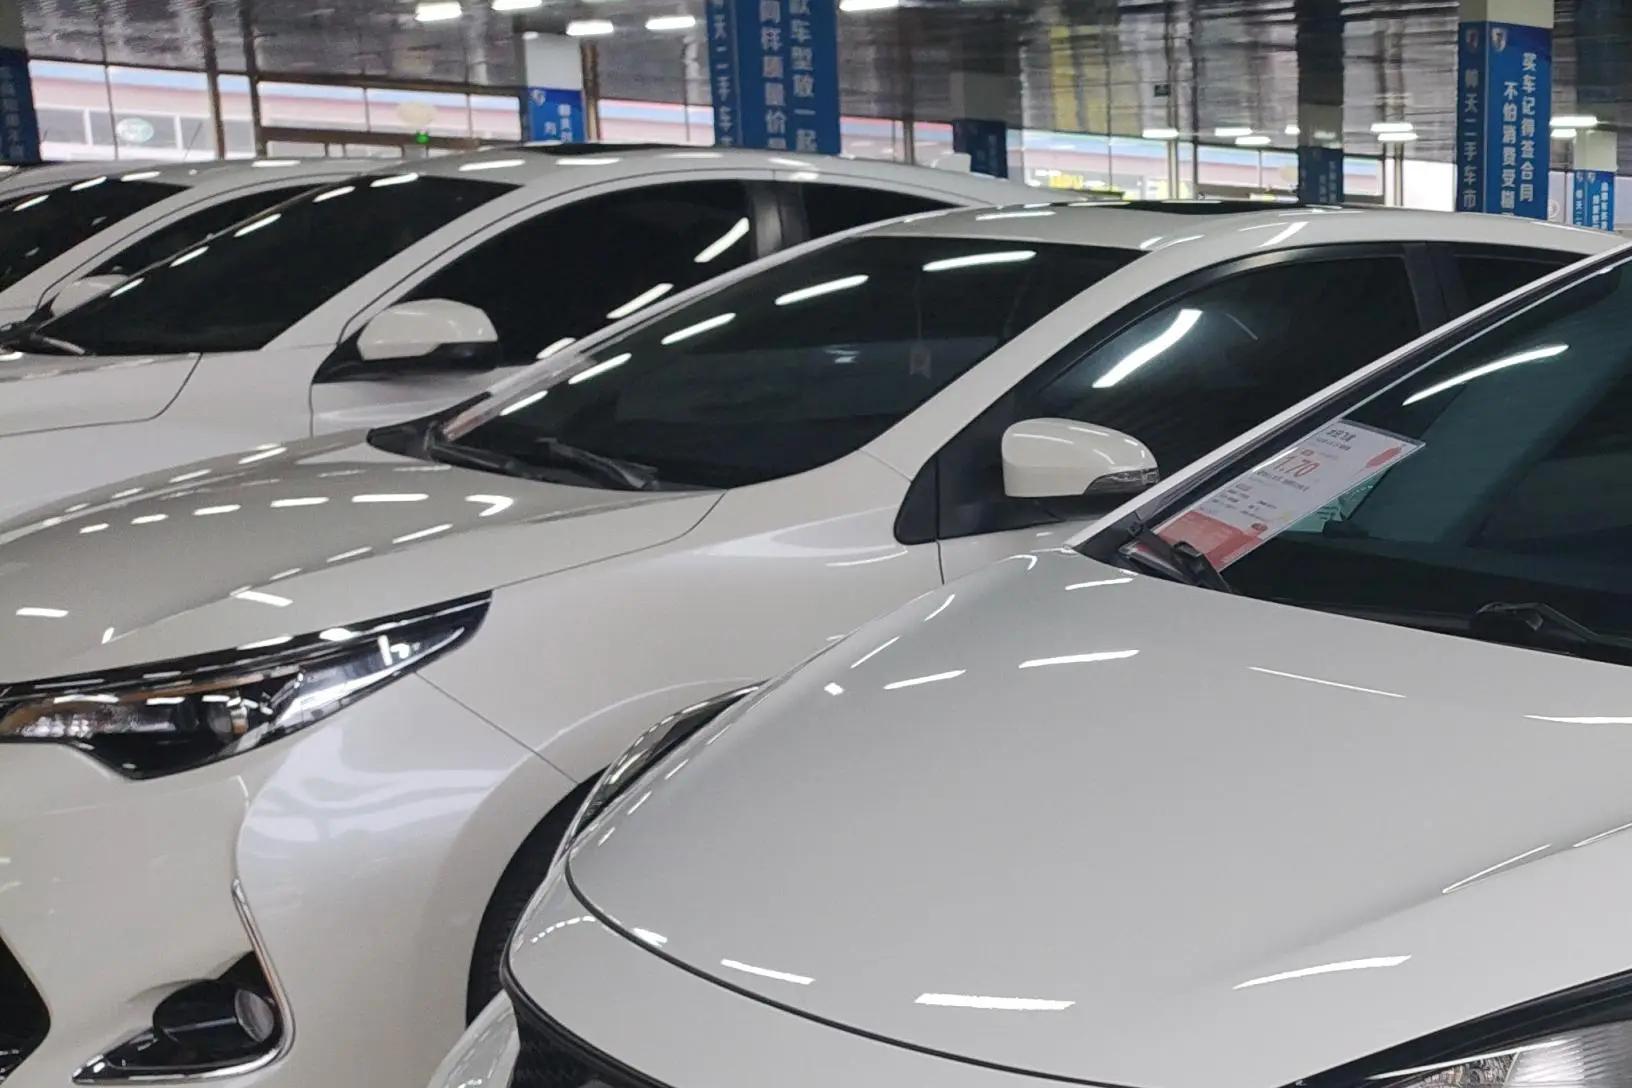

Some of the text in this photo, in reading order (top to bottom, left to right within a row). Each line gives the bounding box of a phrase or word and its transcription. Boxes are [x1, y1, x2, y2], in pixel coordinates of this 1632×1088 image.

[1519, 52, 1537, 202] 买车记得签合同
